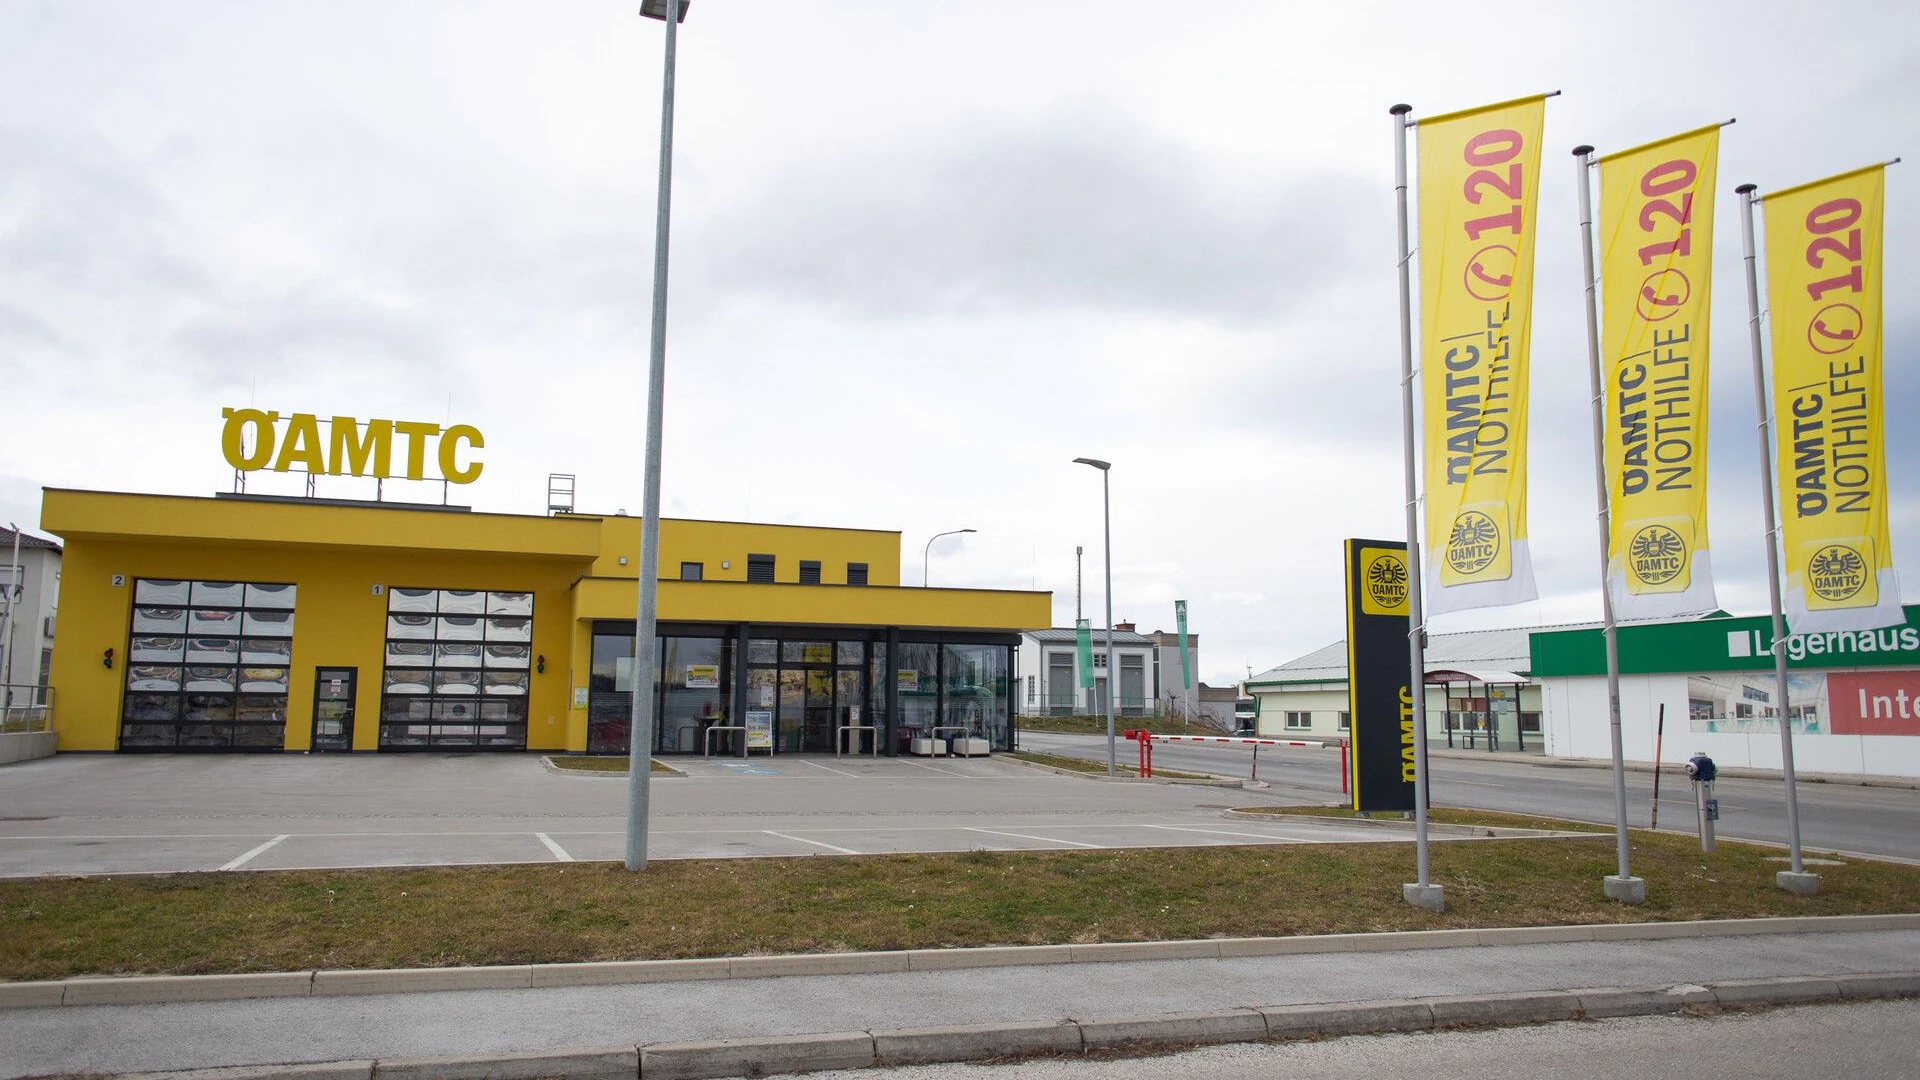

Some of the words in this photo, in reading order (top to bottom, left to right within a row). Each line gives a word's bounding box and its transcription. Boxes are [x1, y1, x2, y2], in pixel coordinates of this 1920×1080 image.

[1464, 129, 1523, 241] 120
[1638, 159, 1697, 266] 120
[1806, 198, 1862, 301] 120
[221, 407, 485, 485] ÖAMTC
[1445, 345, 1480, 485] ÖAMTC
[1619, 364, 1649, 497] ÖAMTC
[1653, 324, 1692, 491] NOTHILFE
[1792, 394, 1828, 518] ÖAMTC
[1829, 356, 1870, 513] NOTHILFE
